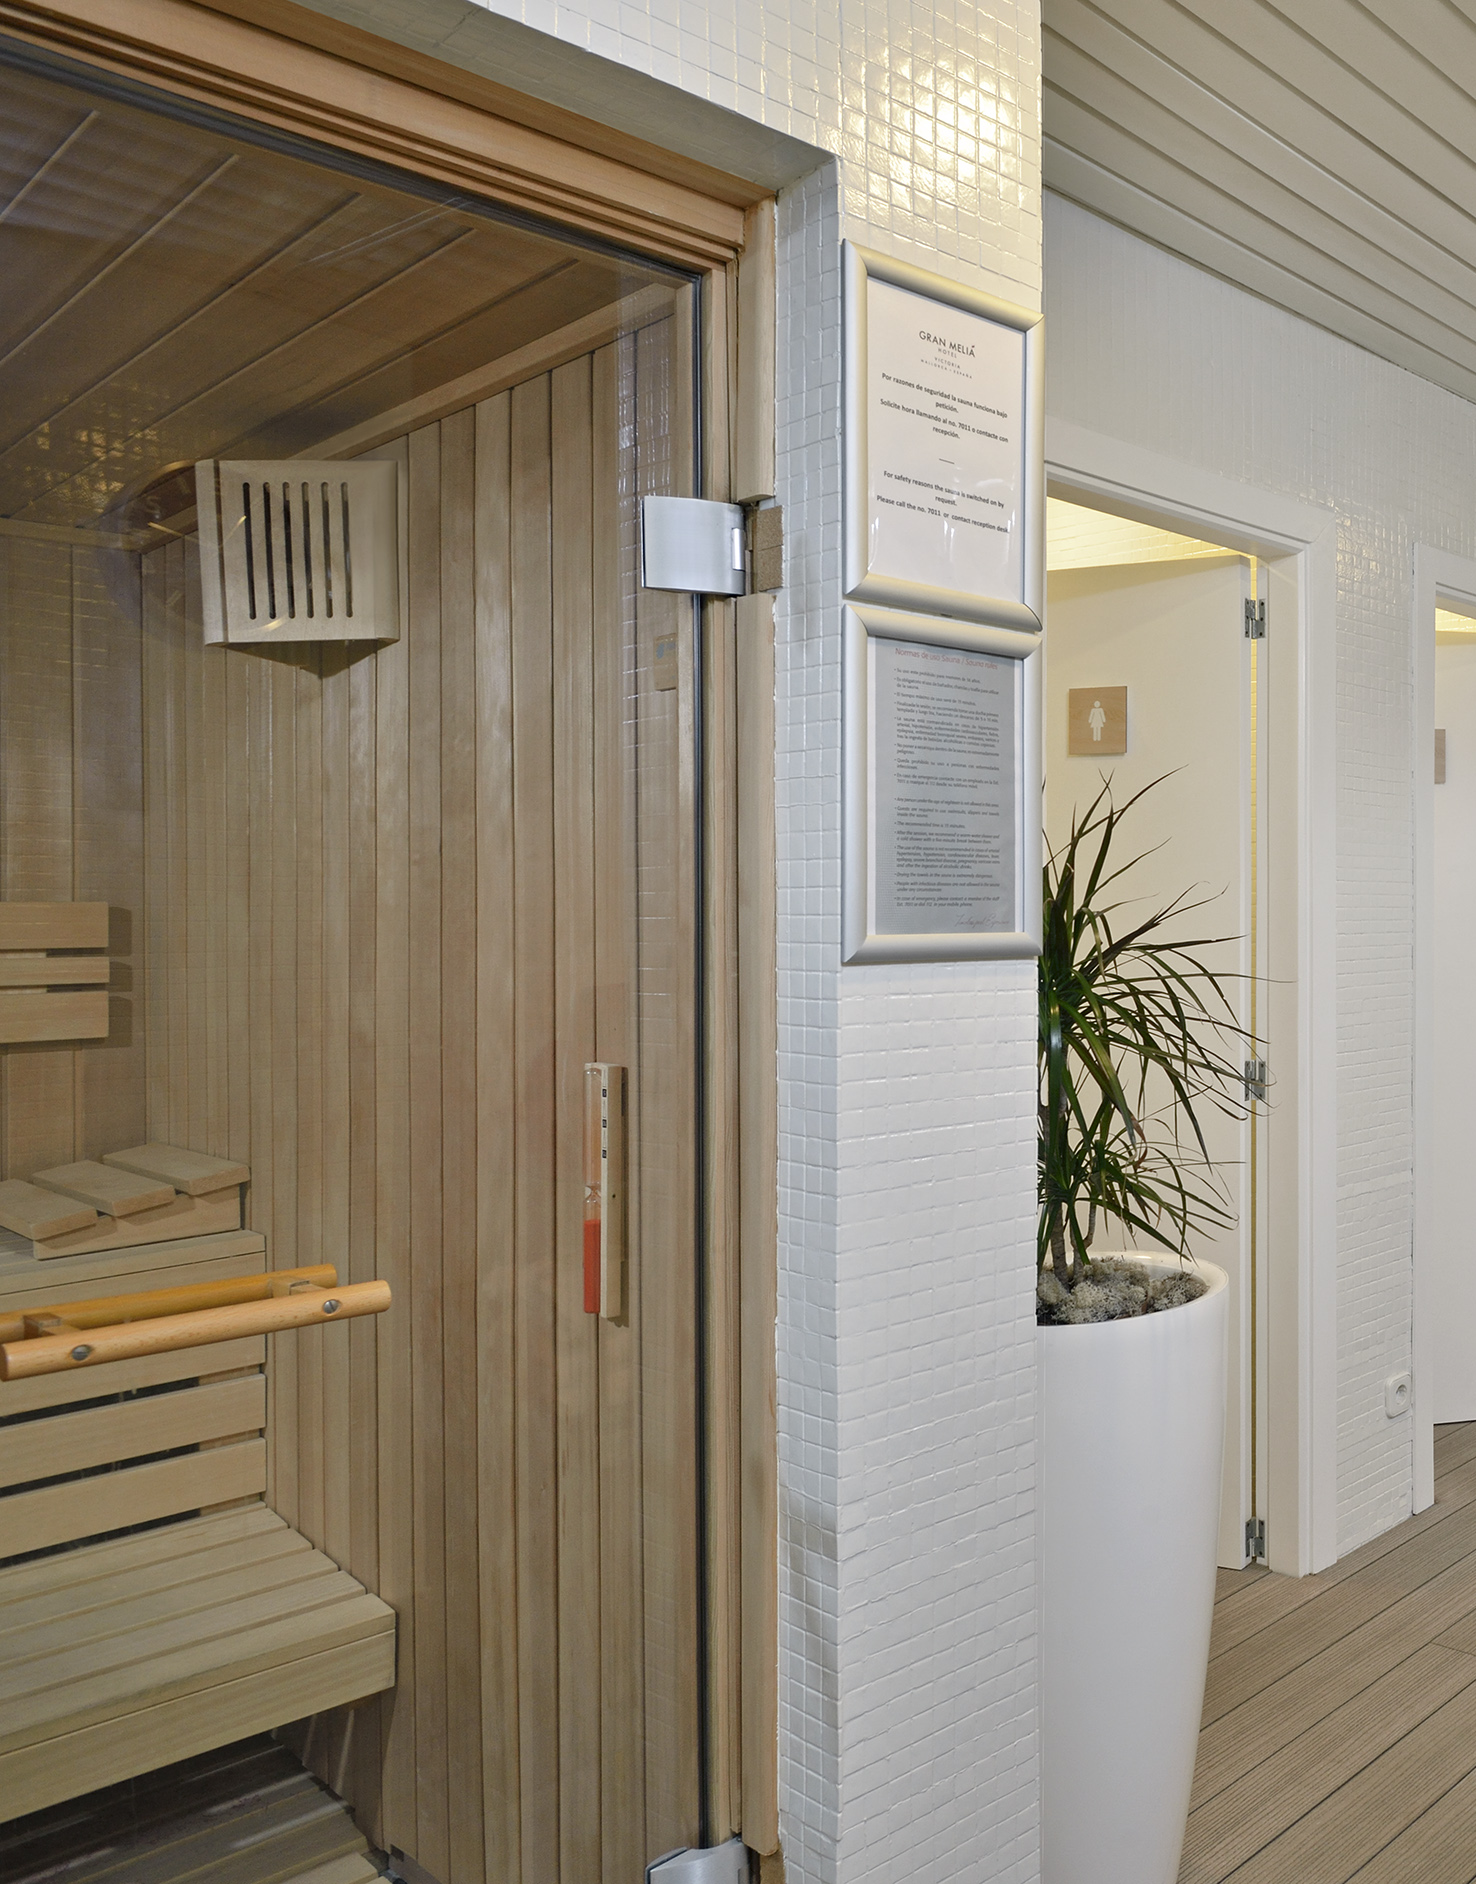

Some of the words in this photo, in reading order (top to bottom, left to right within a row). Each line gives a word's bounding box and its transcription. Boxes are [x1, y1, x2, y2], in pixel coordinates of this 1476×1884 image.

[918, 330, 946, 347] GRAN
[949, 341, 976, 358] MELIÁ
[937, 348, 958, 359] HOTEL
[934, 357, 961, 370] VICTORIA
[881, 372, 892, 381] Por
[893, 376, 915, 389] razones
[916, 383, 923, 391] de
[924, 386, 951, 400] seguridad
[951, 393, 957, 401] la
[957, 397, 973, 407] sauna
[973, 401, 996, 415] funciona
[996, 407, 1008, 419] bajo
[935, 401, 959, 413] petición.
[880, 398, 901, 410] Solicite
[901, 404, 915, 415] hora
[916, 407, 942, 423] llamando
[942, 415, 948, 424] al
[948, 419, 957, 428] no.
[958, 422, 971, 432] 7011
[976, 428, 998, 440] contacte
[999, 435, 1009, 443] con
[932, 426, 960, 439] recepción.
[883, 470, 893, 479] For
[894, 473, 912, 485] safety
[912, 479, 934, 490] reasons
[934, 484, 944, 492] the
[945, 487, 960, 497] sauna
[967, 492, 990, 505] switched
[998, 500, 1005, 509] by
[935, 495, 957, 506] request.
[877, 494, 895, 506] Please
[896, 500, 906, 508] call
[907, 502, 916, 511] the
[927, 507, 941, 517] 7011
[951, 514, 971, 525] contact
[972, 518, 996, 531] reception
